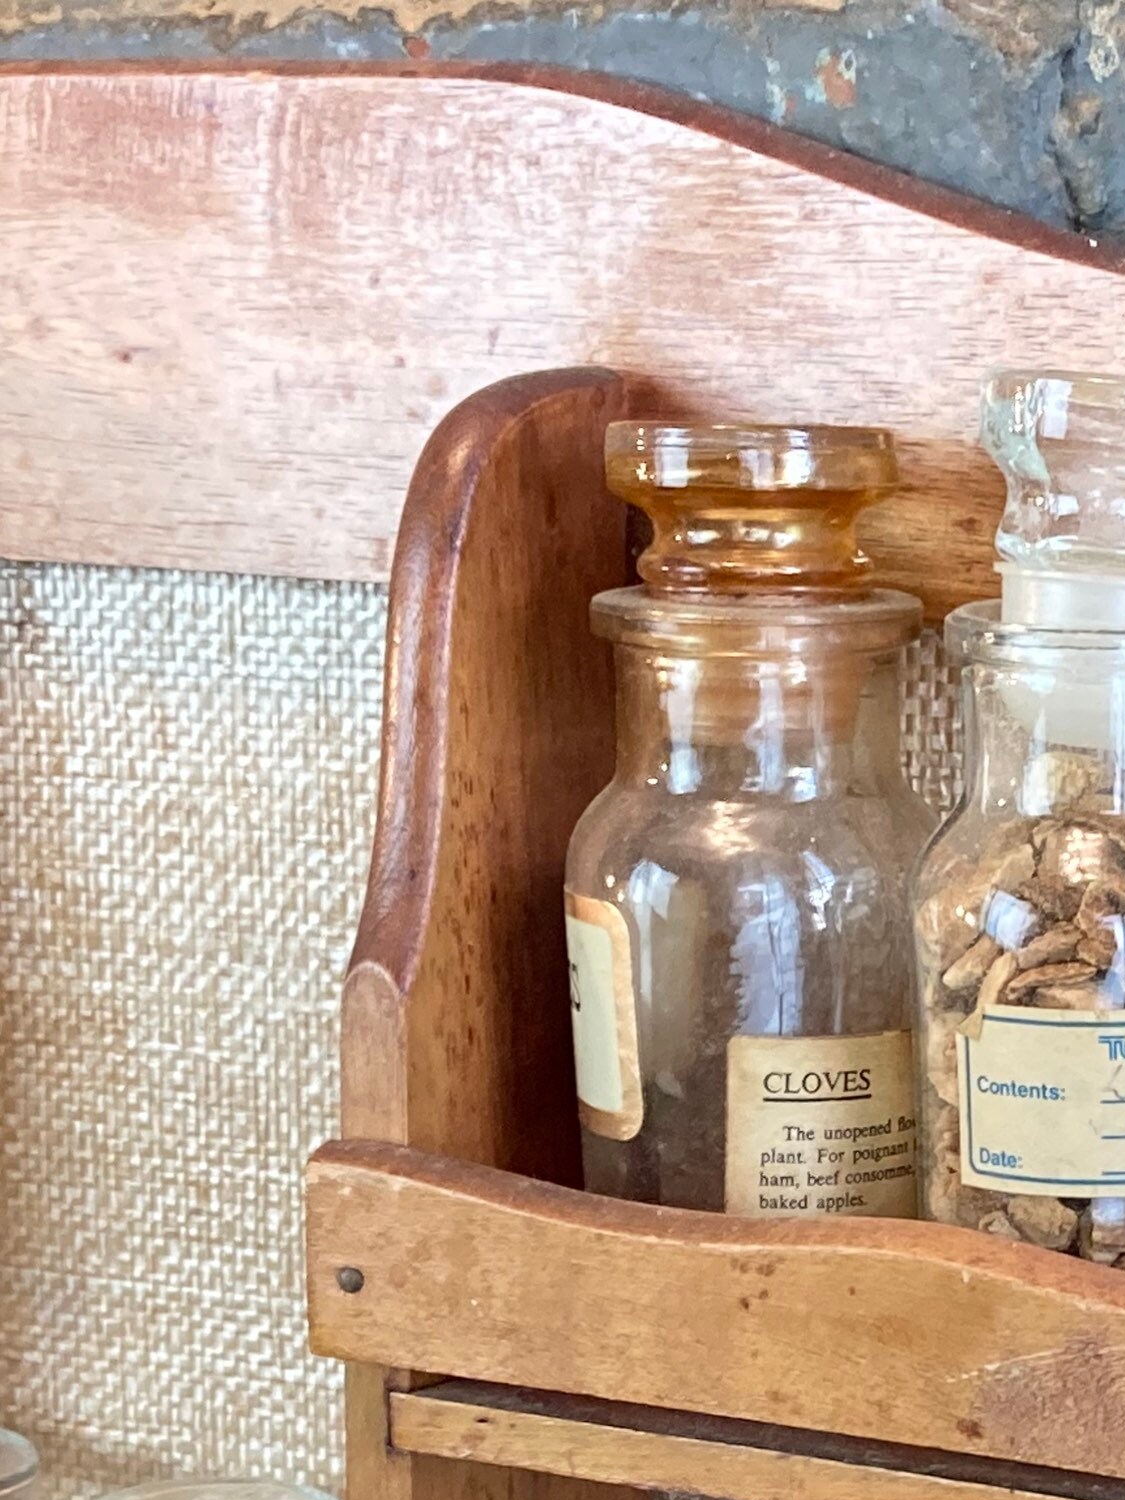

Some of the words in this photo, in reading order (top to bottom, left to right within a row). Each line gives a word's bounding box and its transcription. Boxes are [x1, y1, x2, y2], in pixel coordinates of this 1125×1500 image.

[762, 1069, 872, 1096] CLOVES
[976, 1075, 1066, 1101] Contents:
[783, 1126, 815, 1142] The
[823, 1118, 892, 1143] unopened
[760, 1149, 807, 1167] plant.
[817, 1148, 845, 1164] For
[852, 1141, 909, 1165] poignant
[979, 1147, 1024, 1169] Date:
[759, 1171, 801, 1189] ham,
[807, 1169, 840, 1187] beef
[759, 1194, 808, 1210] baked
[816, 1191, 867, 1213] apples.
